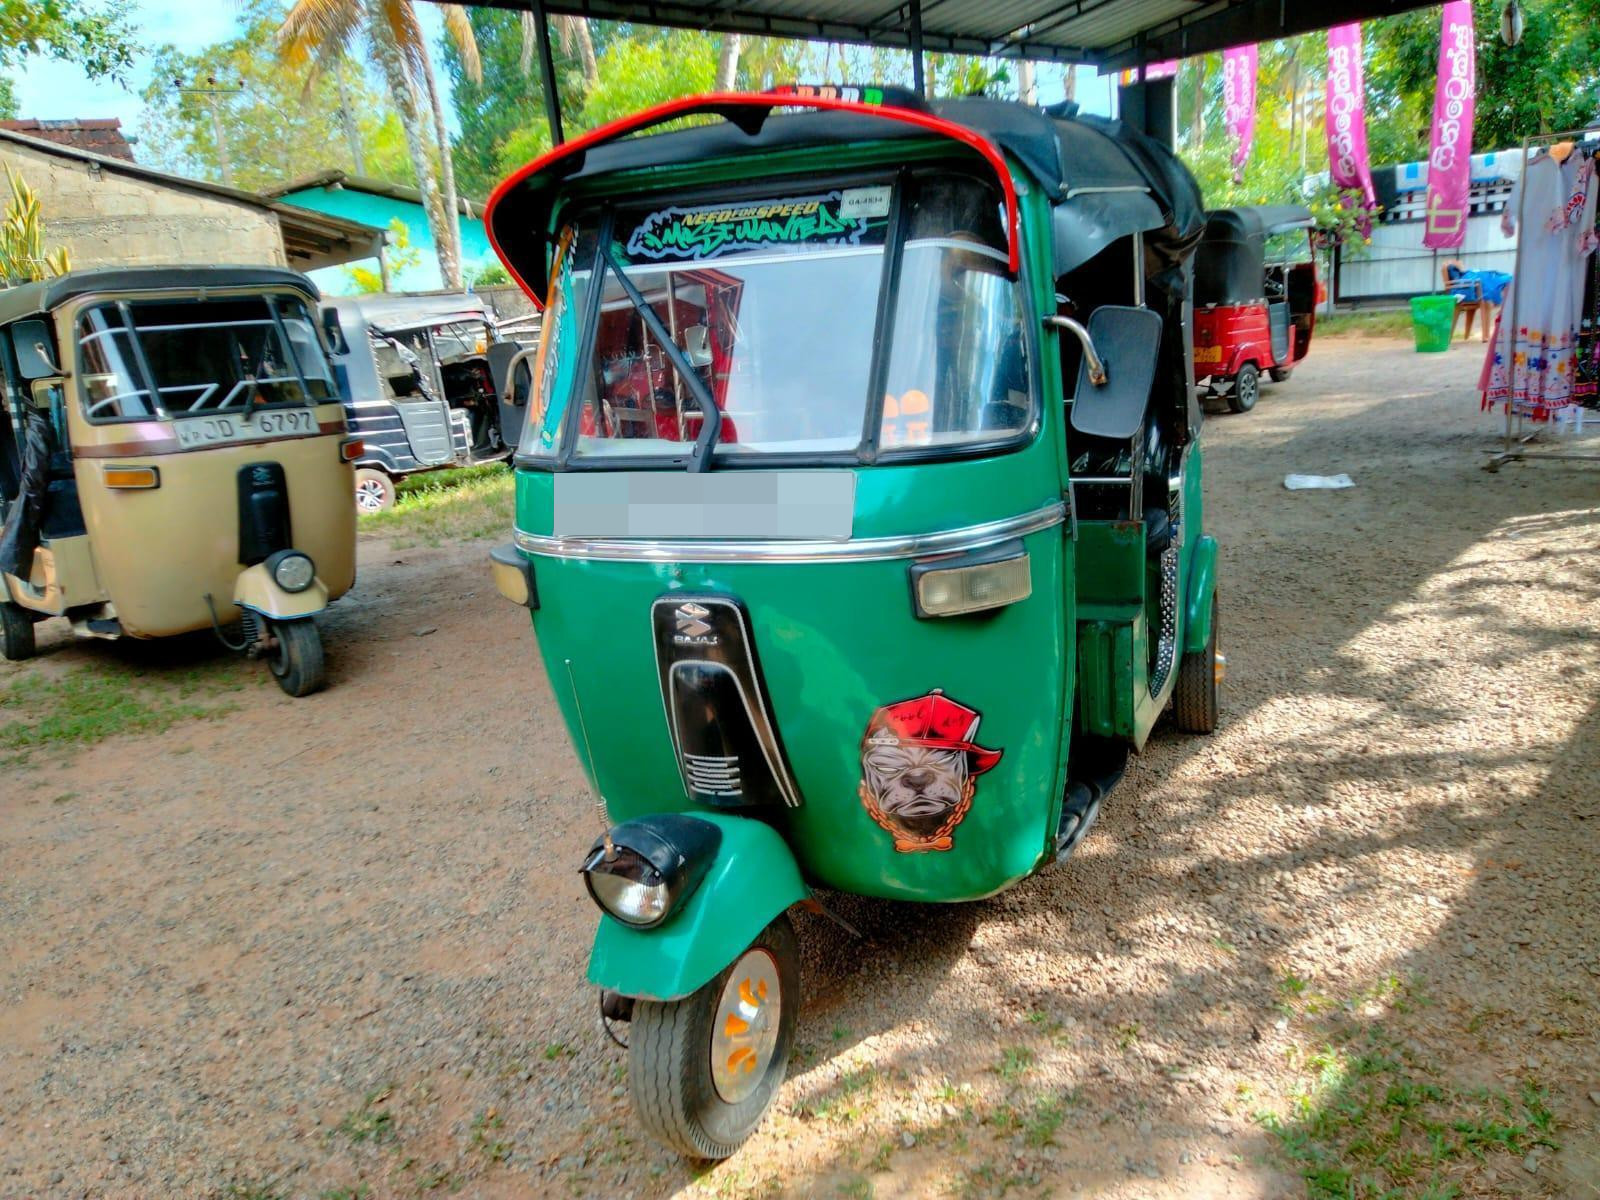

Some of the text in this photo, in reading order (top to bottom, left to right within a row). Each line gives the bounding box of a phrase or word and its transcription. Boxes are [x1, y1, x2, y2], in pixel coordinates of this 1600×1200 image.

[682, 211, 731, 226] NEED
[759, 201, 820, 219] SPEED
[260, 411, 311, 433] 6797
[674, 635, 718, 645] BAJAJ
